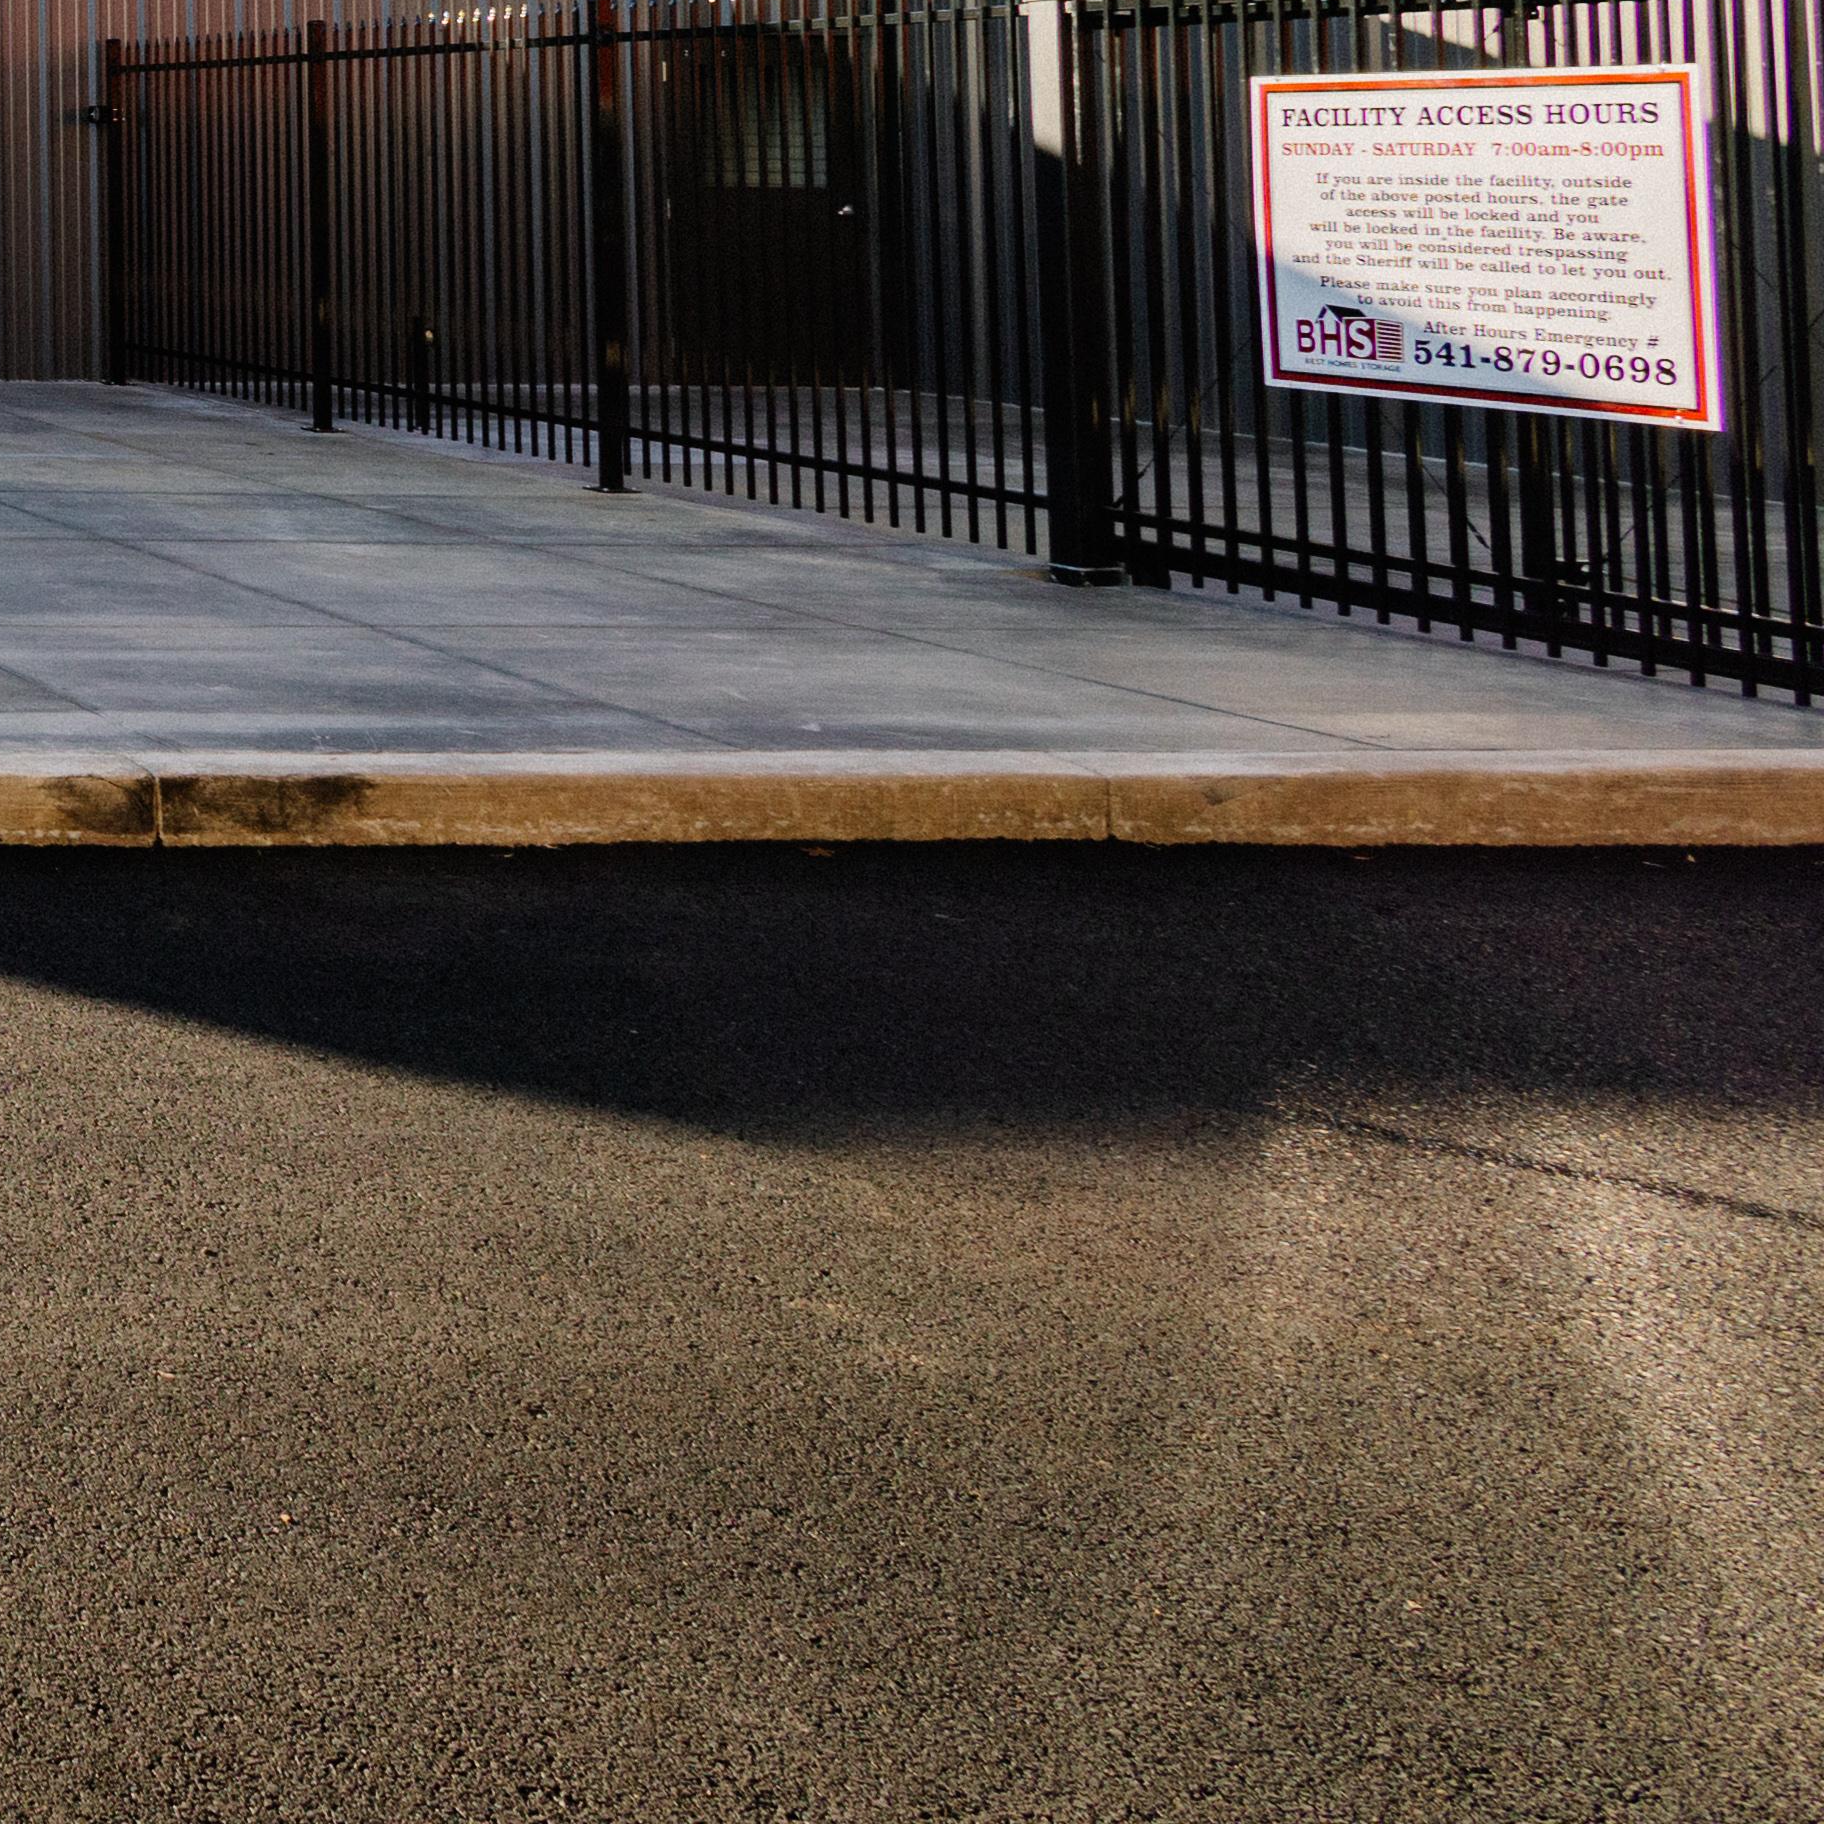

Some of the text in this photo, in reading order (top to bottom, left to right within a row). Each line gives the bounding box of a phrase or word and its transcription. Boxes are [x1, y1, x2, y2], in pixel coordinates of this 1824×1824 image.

[1282, 101, 1660, 127] FACILITY ACCESS HOURS
[1282, 142, 1355, 156] SUNDAY
[1372, 142, 1477, 157] SATURDAY
[1491, 141, 1665, 161] 7:00am-8:00pm
[1316, 173, 1329, 184] If
[1333, 176, 1361, 188] you
[1367, 176, 1393, 185] are
[1399, 174, 1449, 186] inside
[1456, 174, 1483, 186] the
[1561, 176, 1633, 189] outside
[1320, 189, 1336, 201] of
[1340, 189, 1366, 201] the
[1371, 190, 1419, 202] above
[1424, 190, 1481, 205] posted
[1551, 193, 1580, 206] the
[1586, 194, 1629, 209] gate
[1346, 206, 1600, 226] access will be locked and you
[1309, 221, 1337, 233] will
[1343, 222, 1361, 234] be
[1366, 222, 1418, 235] locked
[1424, 224, 1441, 236] in
[1447, 225, 1474, 237] the
[1554, 228, 1576, 241] Be
[1325, 239, 1629, 264] you will be considered trespassing
[1292, 253, 1320, 264] and
[1326, 253, 1351, 265] the
[1355, 254, 1413, 268] Sheriff
[1418, 257, 1449, 270] will
[1455, 259, 1474, 271] be
[1480, 261, 1532, 274] called
[1538, 263, 1556, 275] to
[1561, 263, 1587, 277] let
[1593, 267, 1627, 280] you
[1320, 276, 1658, 309] Please make sure you plan accordingly
[1357, 294, 1373, 305] to
[1378, 295, 1422, 308] avoid
[1428, 297, 1461, 310] this
[1466, 299, 1507, 314] from
[1296, 319, 1374, 359] BHS
[1423, 320, 1660, 351] After Hours Emergency #
[1327, 358, 1358, 369] HOMES
[1361, 361, 1401, 373] STORAGE
[1414, 339, 1678, 386] 541-879-0698
